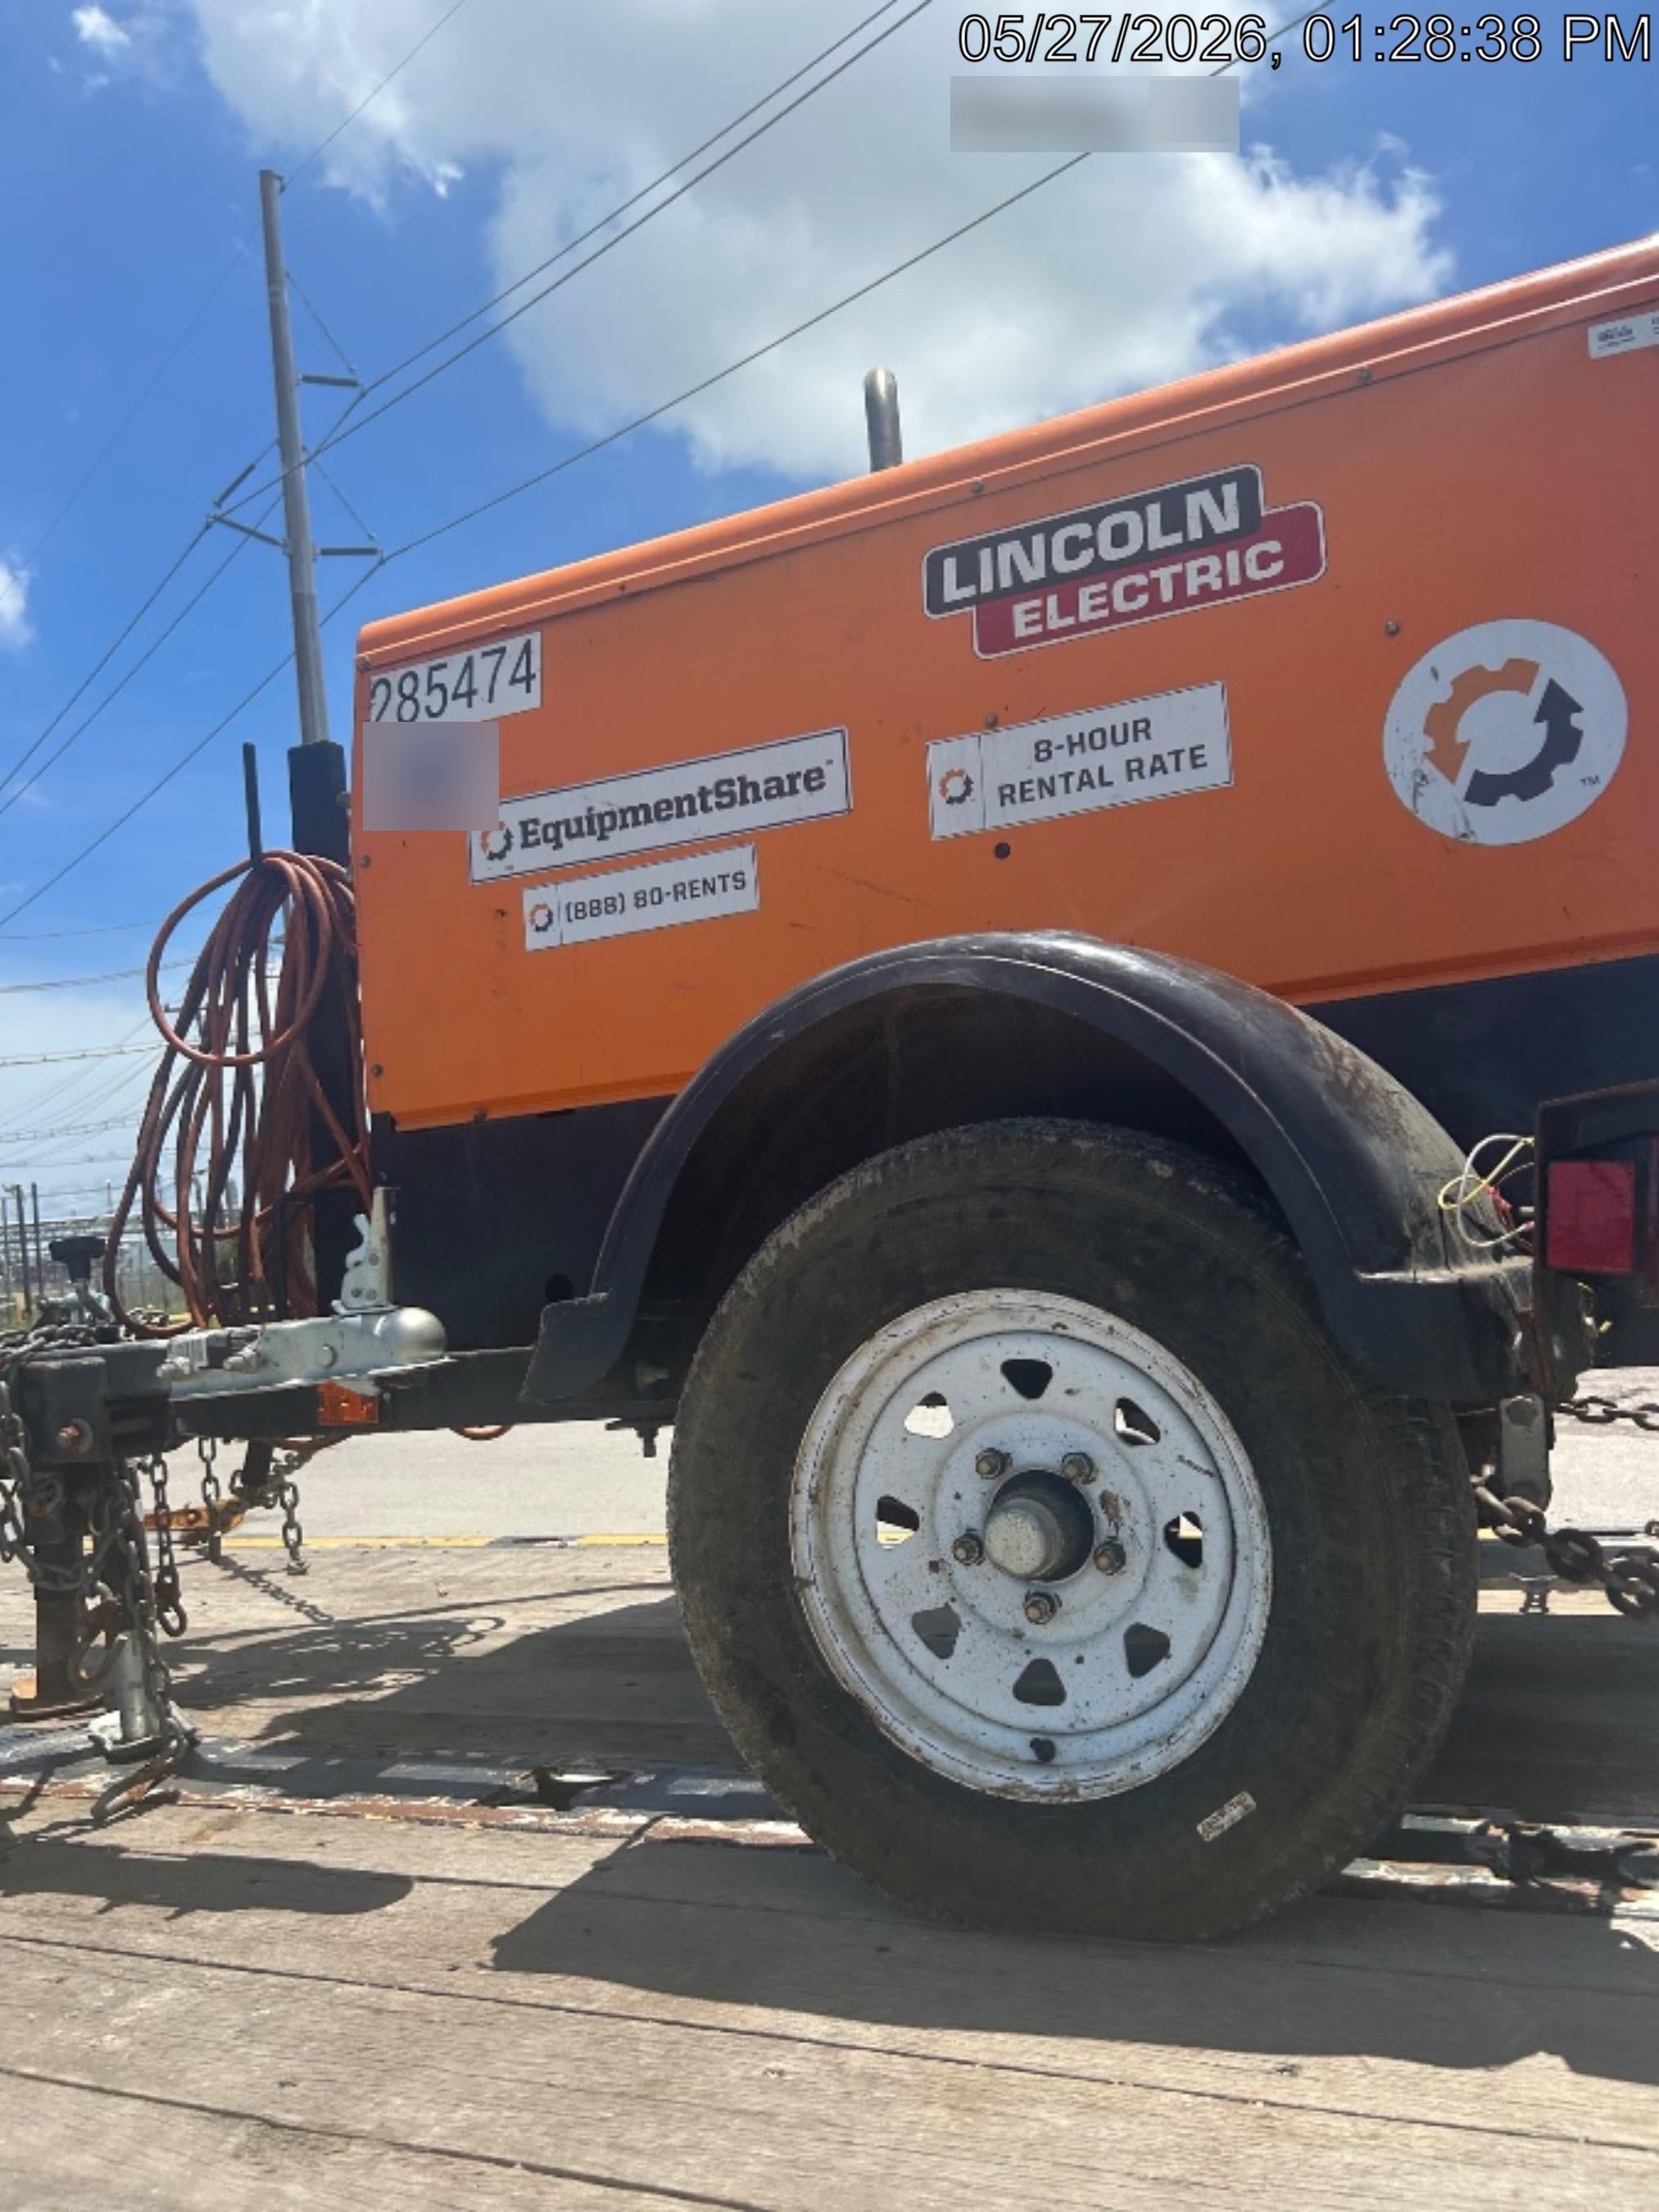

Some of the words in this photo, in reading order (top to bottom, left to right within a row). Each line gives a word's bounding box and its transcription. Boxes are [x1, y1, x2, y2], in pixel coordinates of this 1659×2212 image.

[943, 483, 1240, 603] LINCOLN
[1013, 540, 1284, 638] ELECTRIC
[370, 638, 536, 723] 285474
[997, 766, 1114, 807] RENTAL
[1125, 745, 1207, 782] RATE
[1033, 718, 1152, 763] 8-HOUR
[519, 768, 827, 850] EquipmentShare
[565, 892, 626, 923] (888)
[634, 870, 747, 909] 80-RENTS
